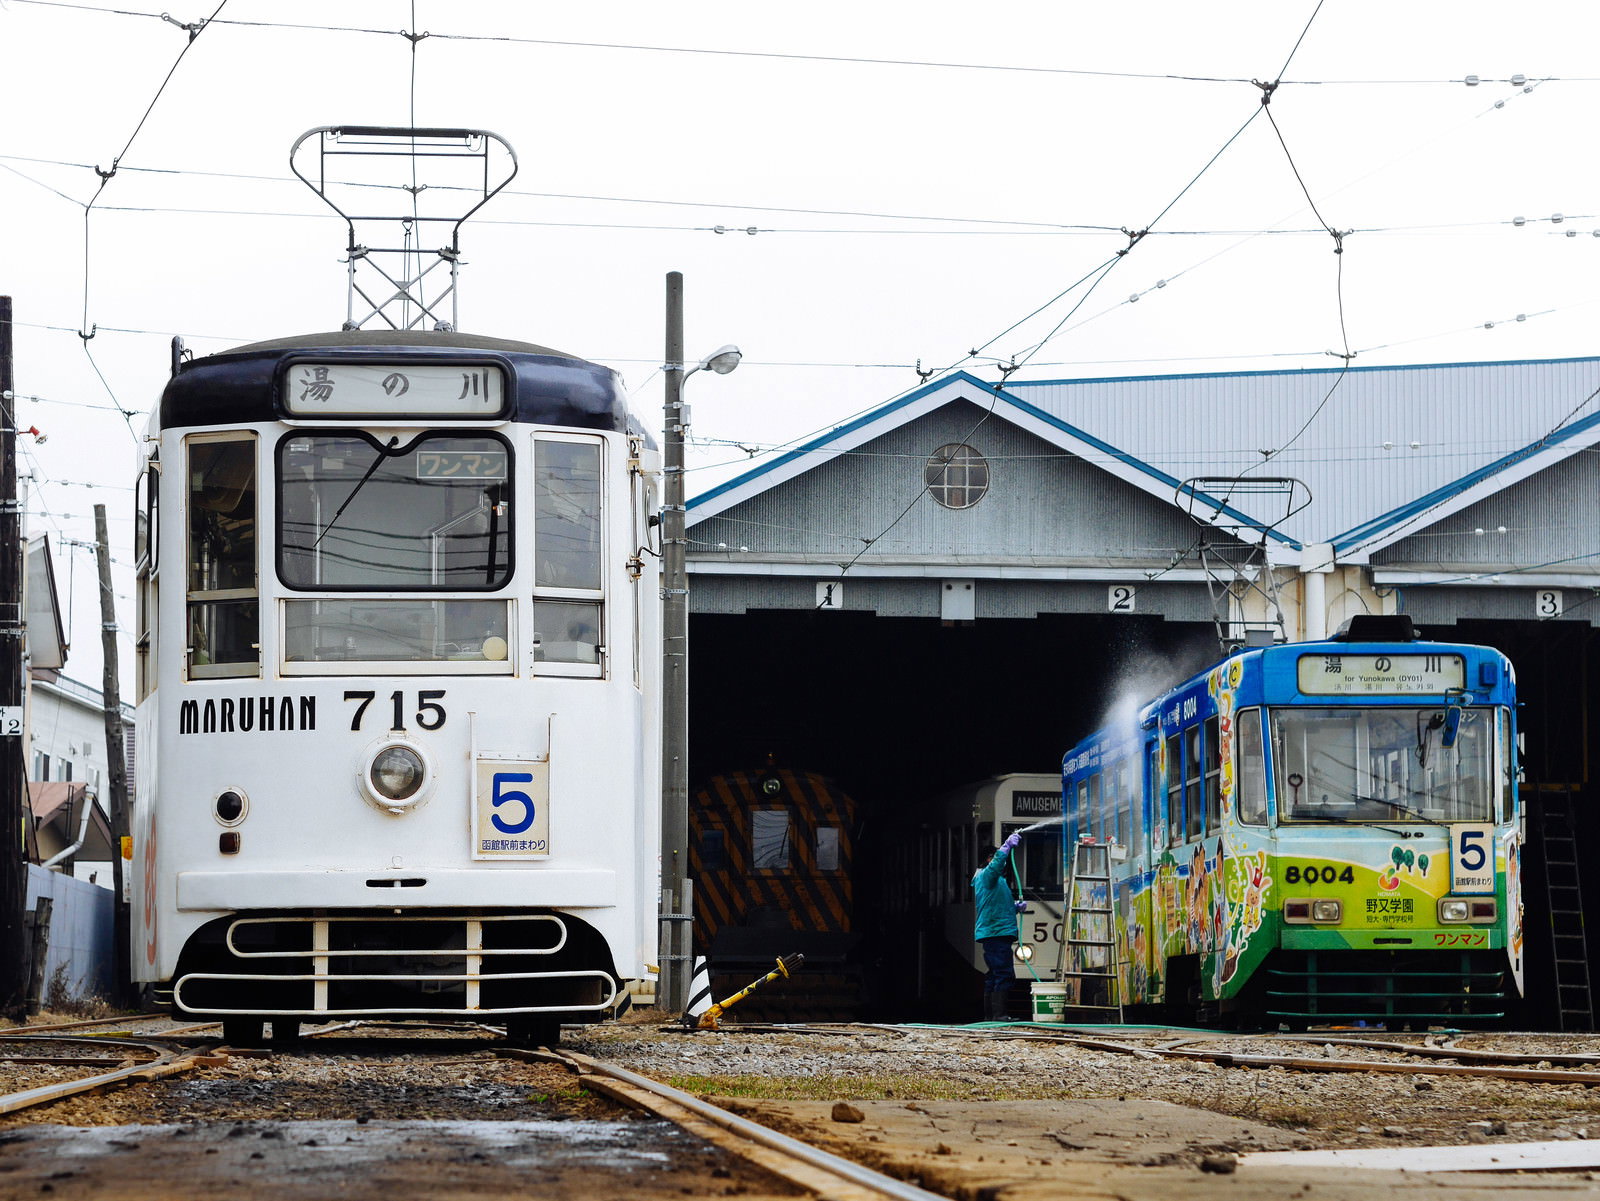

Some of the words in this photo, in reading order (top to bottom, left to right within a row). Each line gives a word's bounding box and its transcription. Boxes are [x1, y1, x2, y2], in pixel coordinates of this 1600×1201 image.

[421, 455, 503, 476] ワンマン
[825, 584, 833, 606] 1
[1114, 587, 1130, 609] 2
[1542, 592, 1557, 614] 3
[179, 695, 316, 735] MARUHAN
[343, 690, 447, 731] 715
[491, 773, 536, 834] 5
[481, 839, 546, 851] 函館駅前まわり
[1460, 831, 1486, 871] 5
[1285, 865, 1355, 885] 8004
[1366, 898, 1414, 913] 野又学園
[1434, 933, 1485, 946] ワンマン
